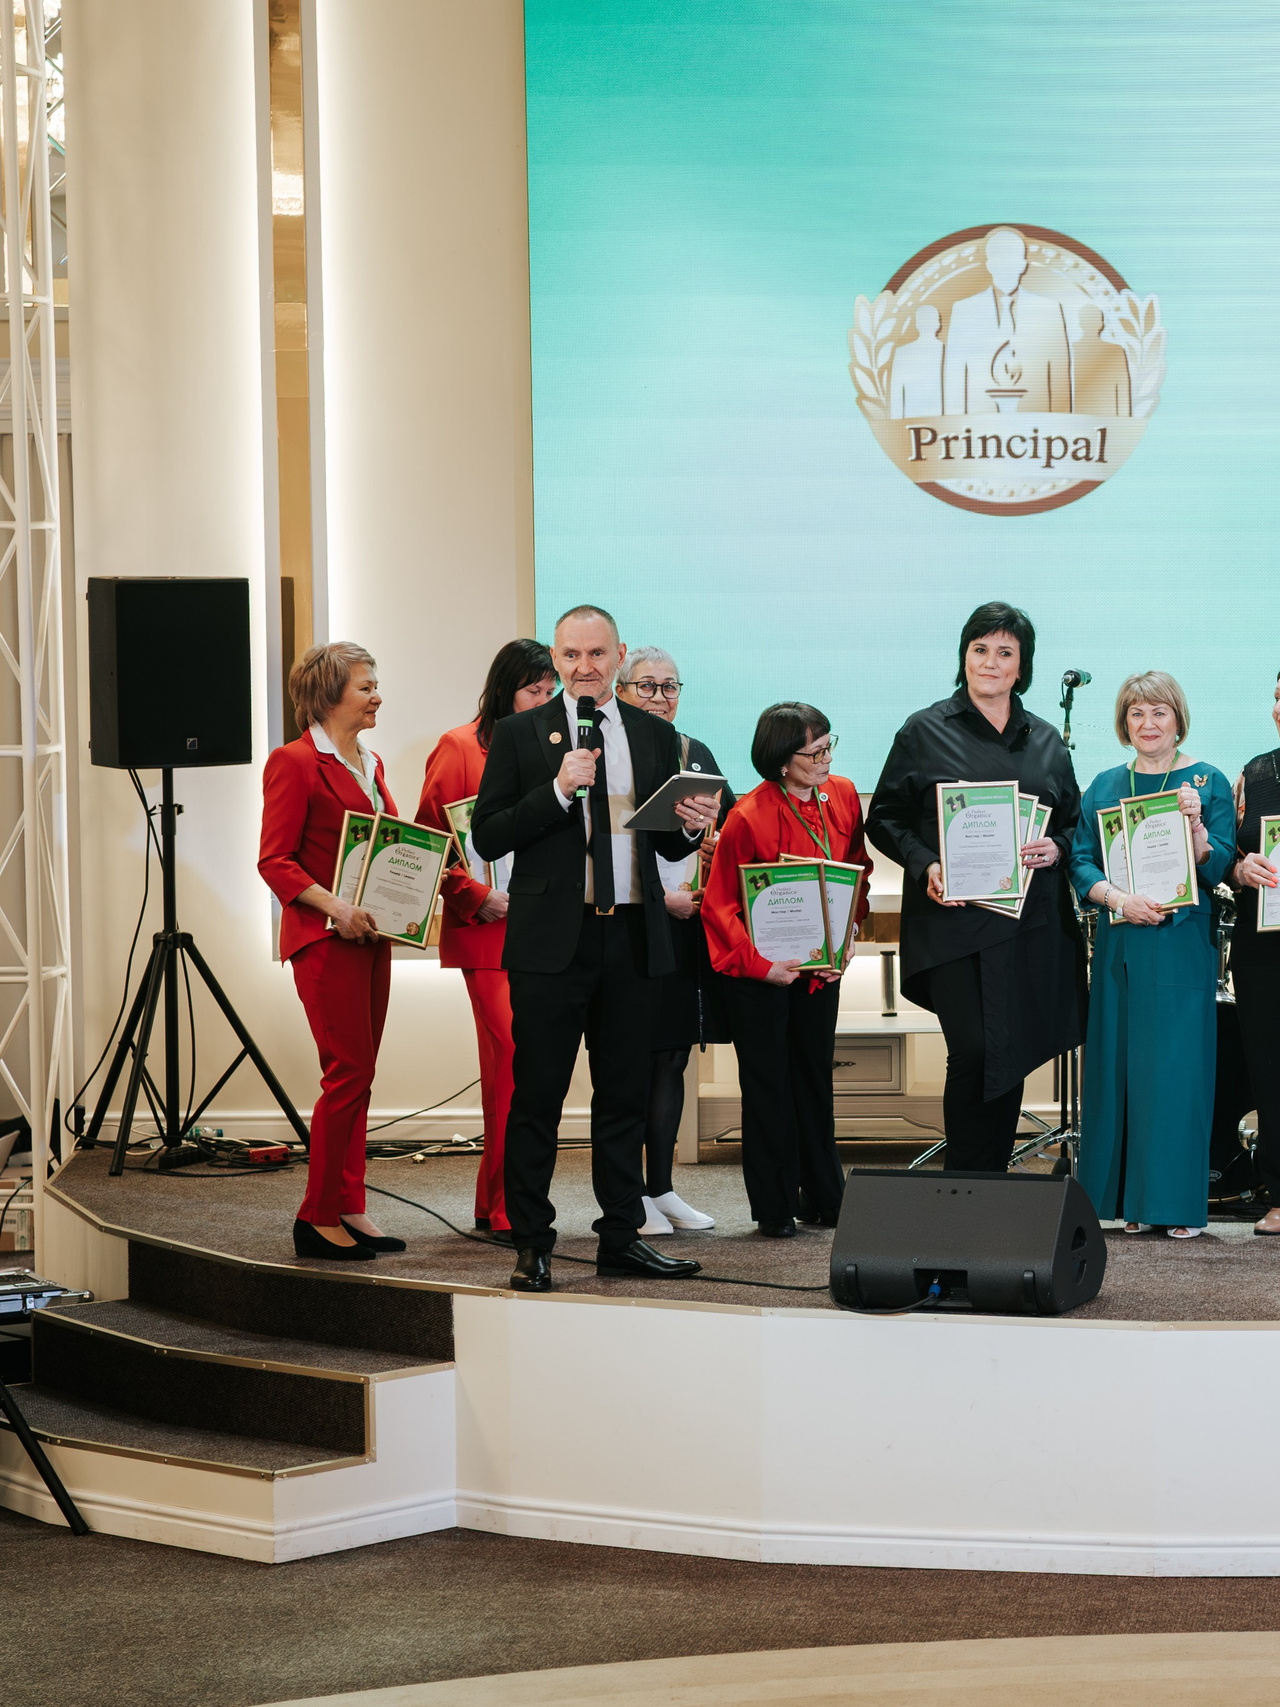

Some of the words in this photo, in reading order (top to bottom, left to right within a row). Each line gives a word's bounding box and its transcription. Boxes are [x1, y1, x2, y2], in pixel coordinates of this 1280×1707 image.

[908, 426, 1107, 469] Principal
[962, 821, 997, 829] ДИПЛОМ
[1143, 830, 1171, 840] ДИПЛОМ
[388, 857, 422, 871] ДИПЛОМ
[768, 897, 804, 905] ДИПЛОМ
